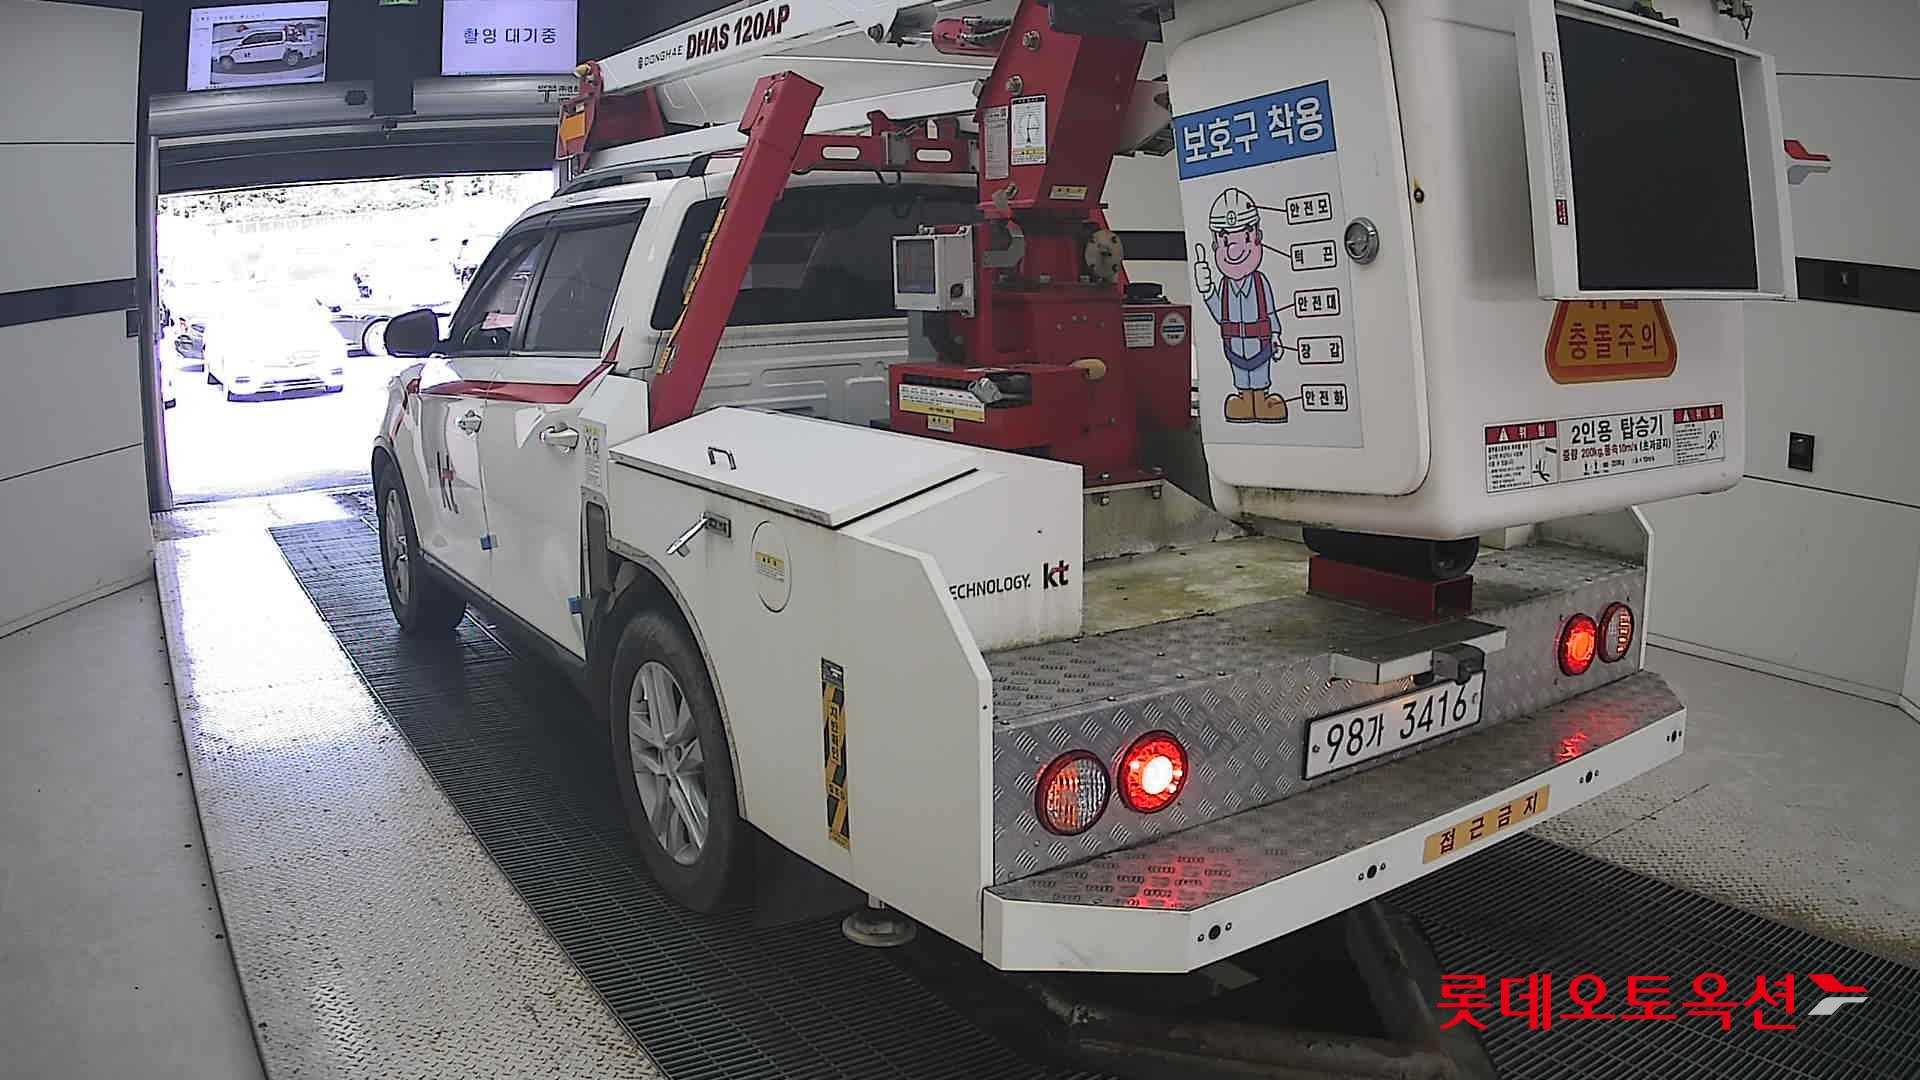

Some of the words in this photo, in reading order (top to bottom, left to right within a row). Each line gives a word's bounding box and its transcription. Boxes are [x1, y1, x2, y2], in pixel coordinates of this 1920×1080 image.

[505, 28, 557, 44] 대기중
[686, 23, 730, 60] DHAS
[733, 4, 790, 46] 120AP
[1184, 111, 1259, 163] 보호구
[1267, 97, 1325, 145] 착용
[1290, 199, 1328, 218] 안전모
[1298, 294, 1337, 311] 안전대
[1567, 321, 1657, 360] 충돌주의
[1305, 390, 1344, 406] 안전화
[1571, 420, 1612, 444] 2인용
[1620, 414, 1664, 440] 탑승기
[1043, 560, 1069, 589] kt
[1327, 713, 1385, 763] 98가
[1400, 685, 1466, 739] 3416
[1440, 791, 1539, 854] 접근금지
